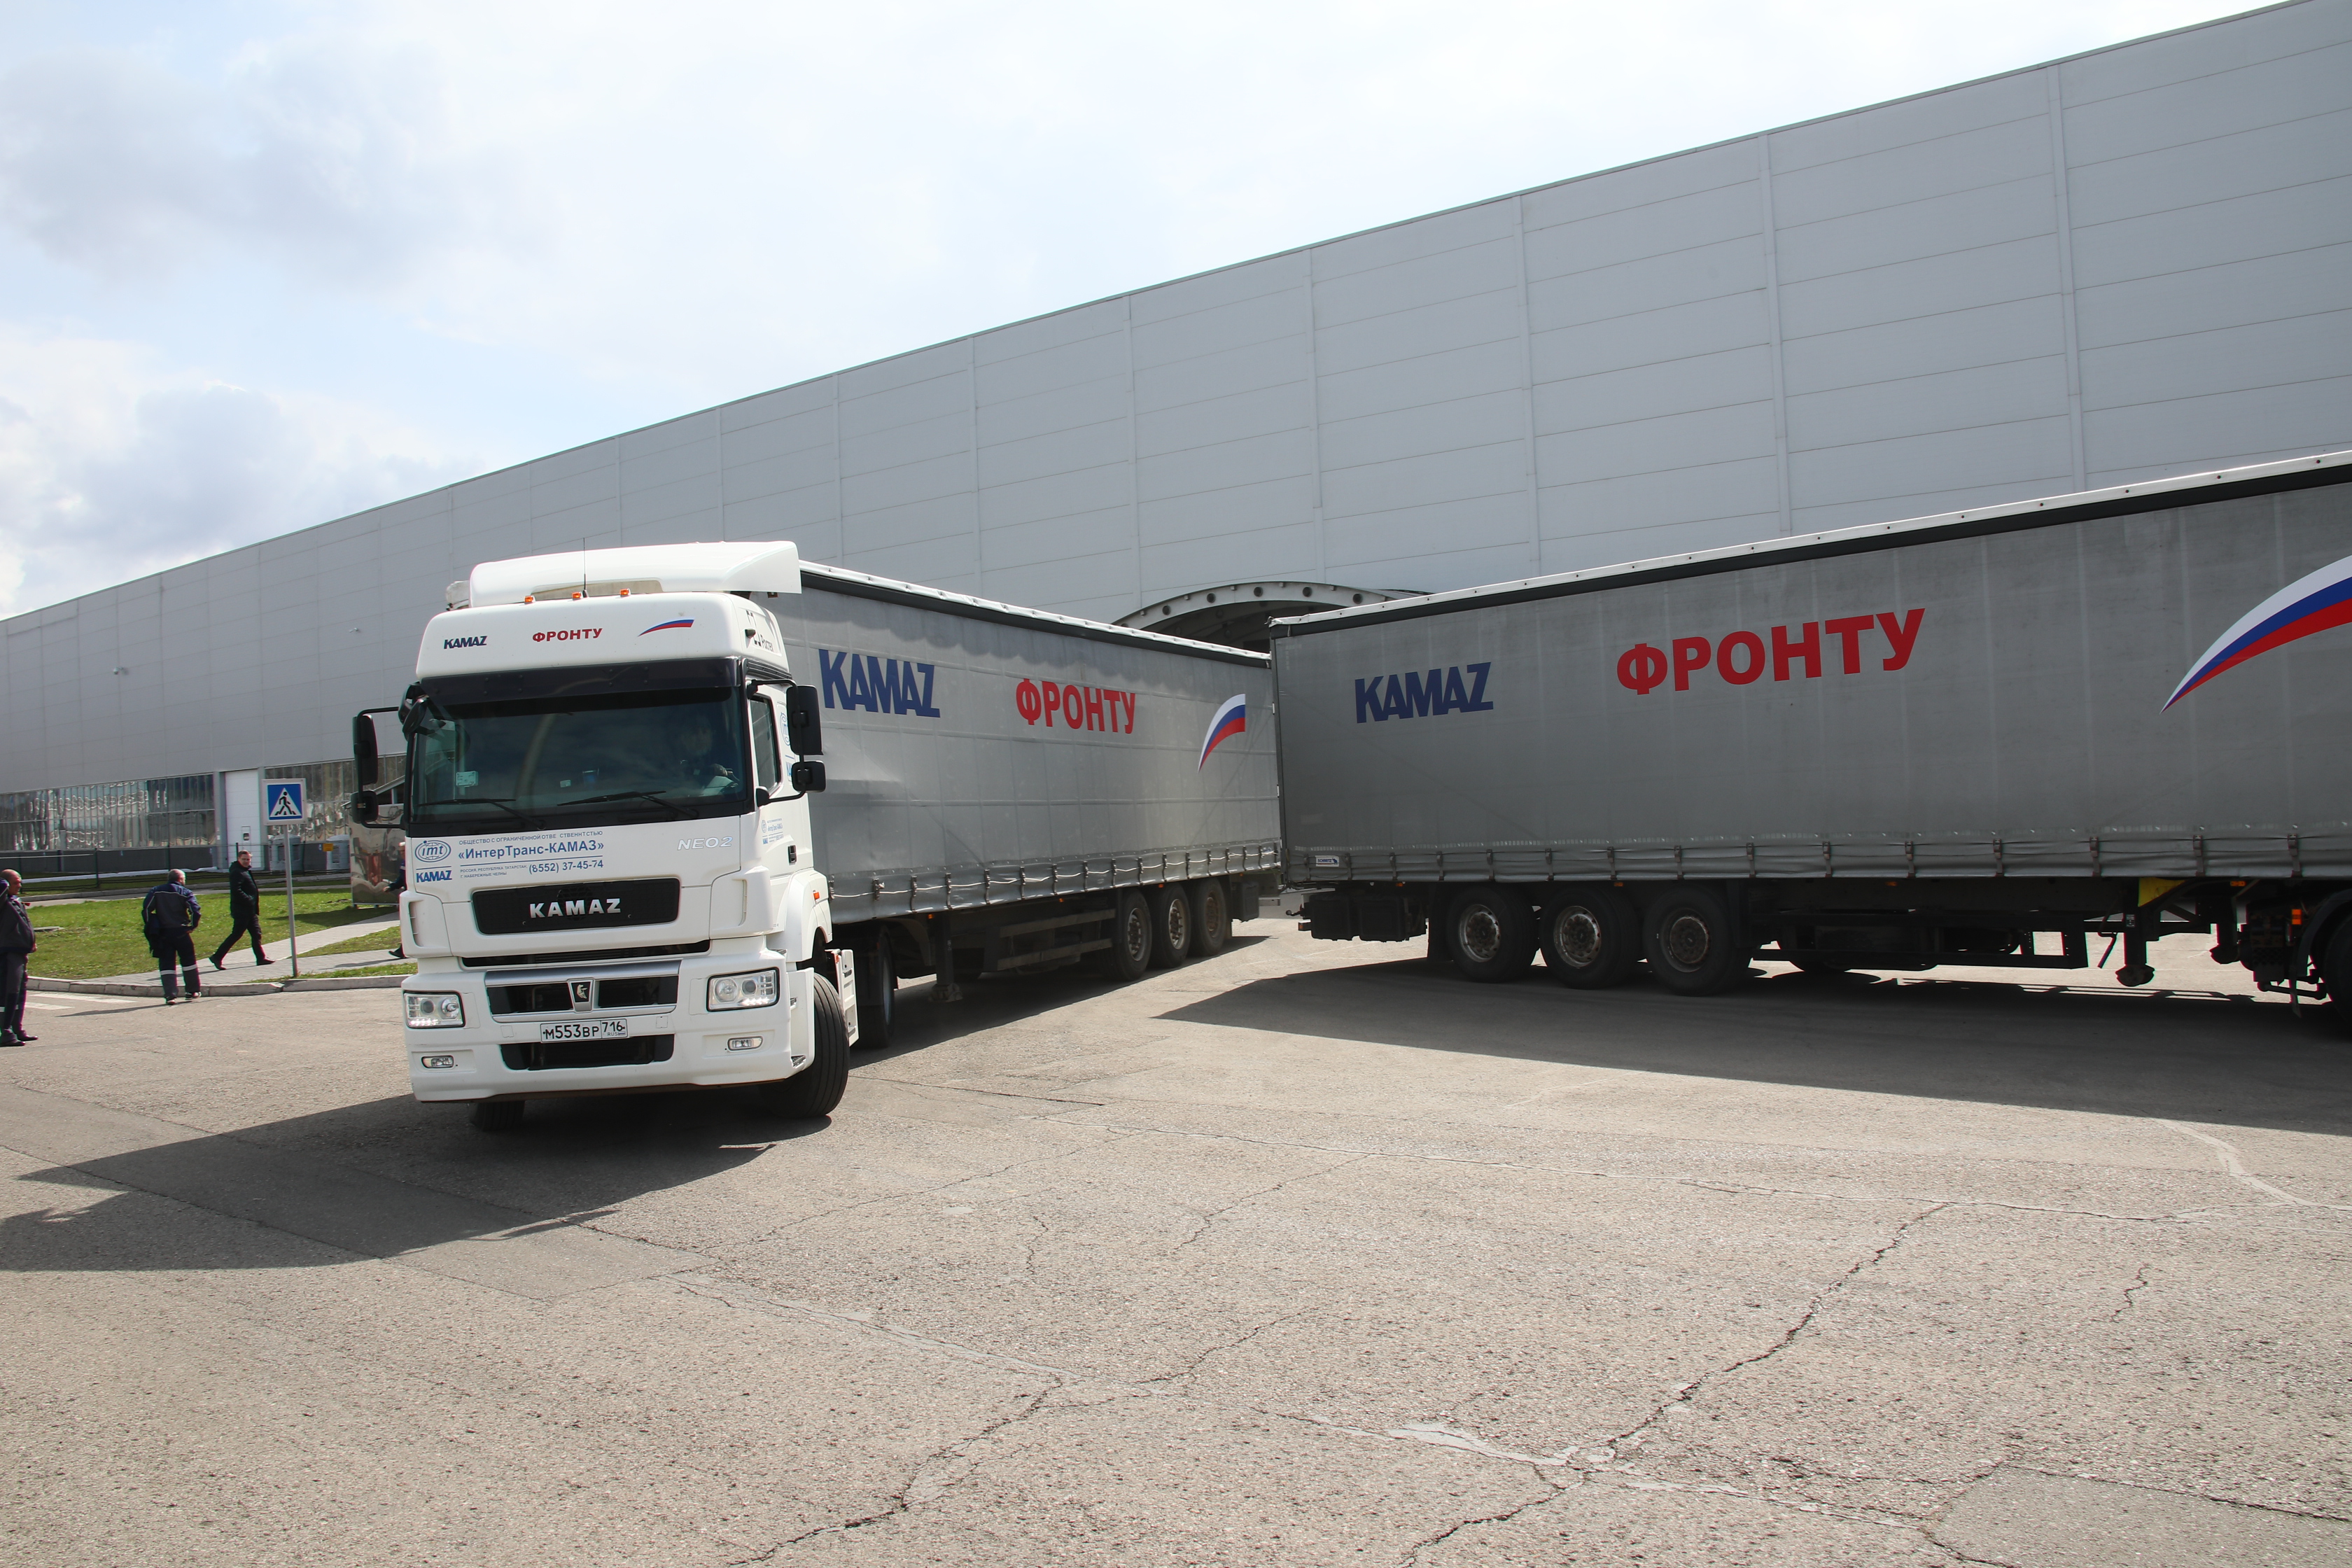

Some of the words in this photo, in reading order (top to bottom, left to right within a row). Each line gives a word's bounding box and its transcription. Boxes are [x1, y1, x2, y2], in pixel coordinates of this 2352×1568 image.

[443, 636, 488, 649] KAMAZ
[533, 628, 603, 642] ФРОНТУ
[1617, 608, 1925, 695] ФРОНТУ
[819, 649, 940, 718] KAMAZ
[1354, 662, 1493, 723] KAMAZ
[1016, 678, 1135, 734] ФРОНТУ
[496, 834, 541, 843] ОГРАНИЧЕННОЙ
[677, 836, 733, 850] NEO2
[458, 840, 604, 860] «ИнтерТранс-КАМАЗ»
[528, 862, 559, 875] (8552)
[562, 860, 604, 871] 37-45-74
[416, 870, 452, 883] KAMAZ
[530, 898, 621, 918] KAMAZ
[602, 1021, 623, 1032] 716
